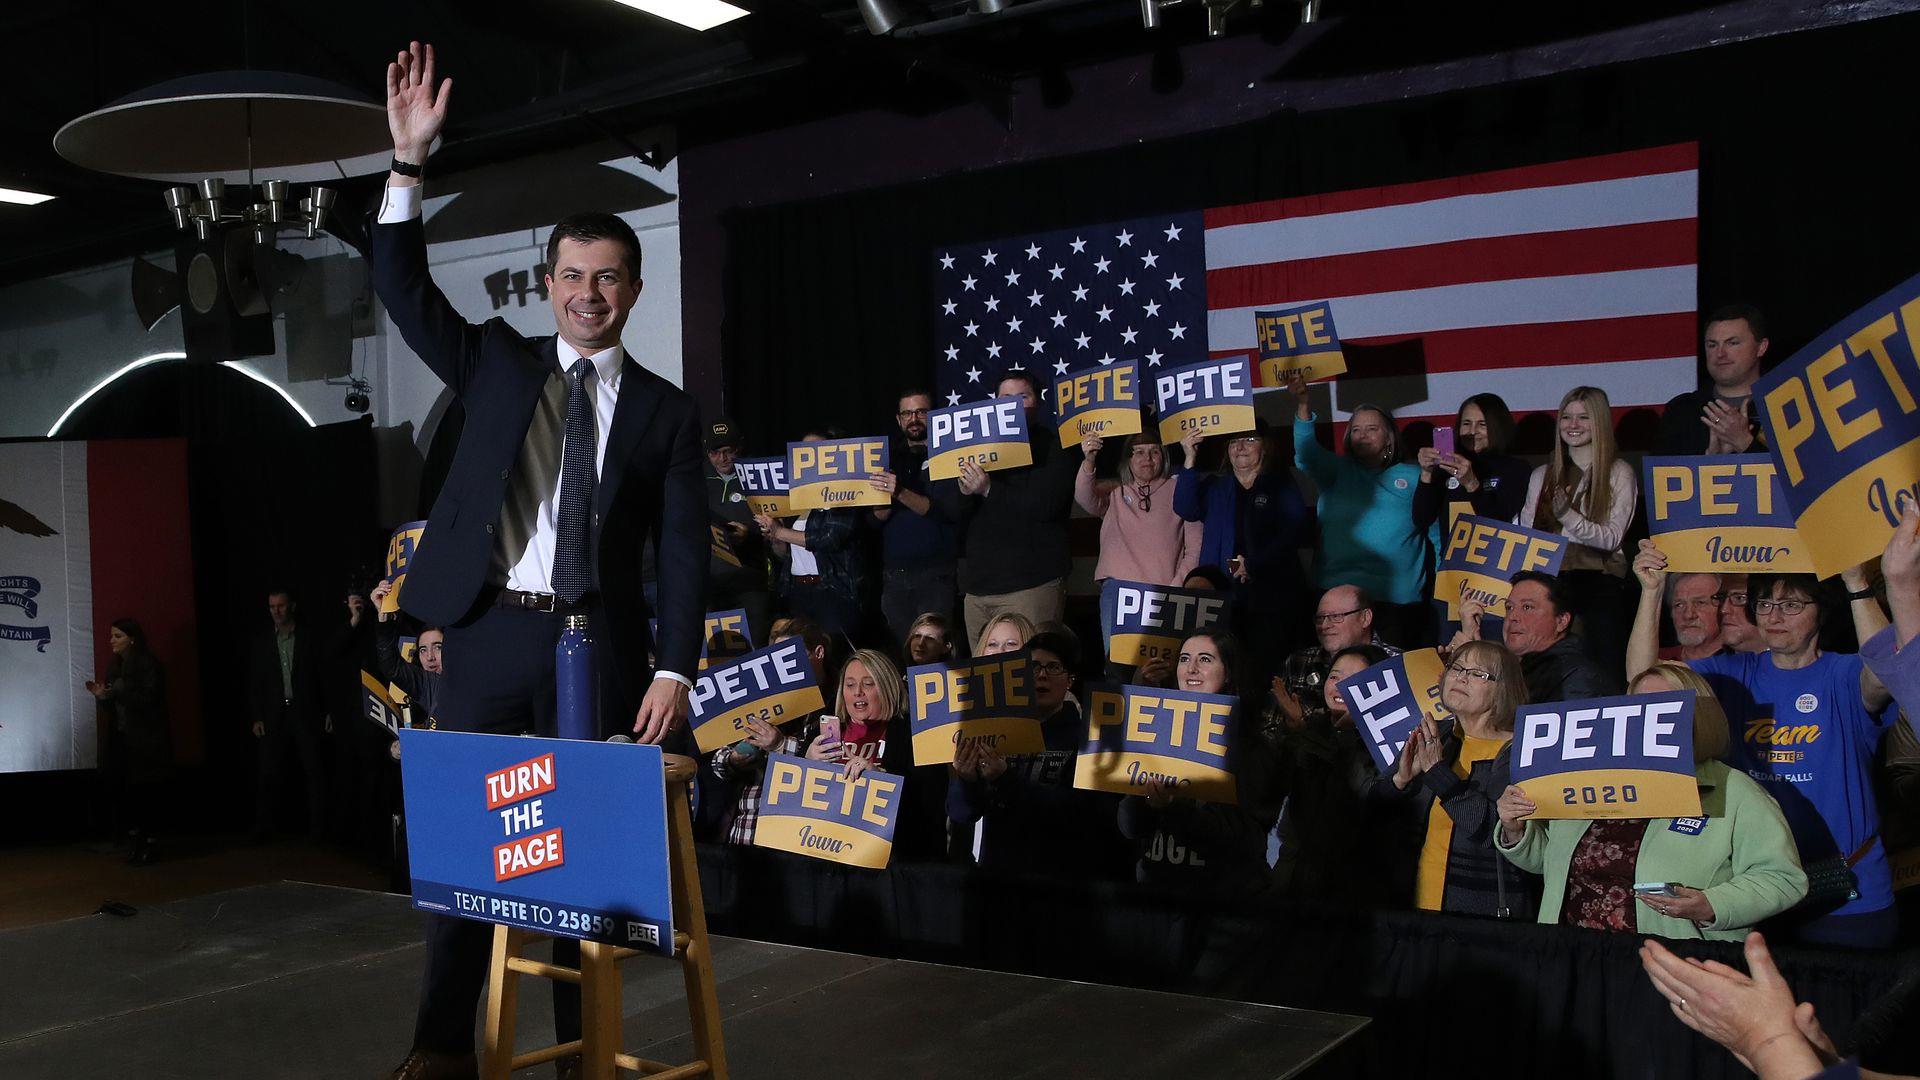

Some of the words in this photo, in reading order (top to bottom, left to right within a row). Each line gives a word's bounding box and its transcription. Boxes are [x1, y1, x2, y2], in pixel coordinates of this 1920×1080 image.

[1258, 308, 1331, 352] PETE
[1057, 366, 1134, 416] PETE
[1156, 362, 1245, 413] PETE
[932, 401, 1021, 448] PETE
[1077, 418, 1113, 437] Iowa
[1181, 414, 1220, 431] 2020
[734, 462, 790, 490] PETE
[792, 442, 886, 480] PETE
[821, 486, 864, 503] Iowa
[1653, 463, 1777, 521] PET
[388, 527, 425, 577] PET
[1706, 536, 1790, 564] Iowa
[0, 579, 29, 588] GHTS
[7, 594, 30, 610] WILL
[0, 629, 33, 639] NTAIN
[705, 615, 743, 650] TE
[1140, 644, 1172, 659] 202
[688, 645, 805, 717] PETE
[914, 658, 1029, 721] PETE
[1089, 691, 1233, 756] PETE
[1519, 701, 1684, 768] PETE
[1744, 718, 1822, 746] Team
[1769, 752, 1794, 761] PETE
[487, 757, 552, 803] TURN
[1748, 769, 1782, 782] CEDAR
[1785, 773, 1813, 782] FALLS
[767, 760, 897, 827] PETE
[1563, 785, 1638, 804] 2020
[500, 799, 544, 836] THE
[1679, 819, 1700, 828] PETE
[498, 833, 559, 875] PAGE
[799, 825, 853, 853] Iowa
[454, 891, 487, 914] TEXT
[491, 897, 528, 921] PETE
[531, 903, 553, 925] TO
[557, 909, 615, 936] 25859
[629, 925, 657, 941] PETE
